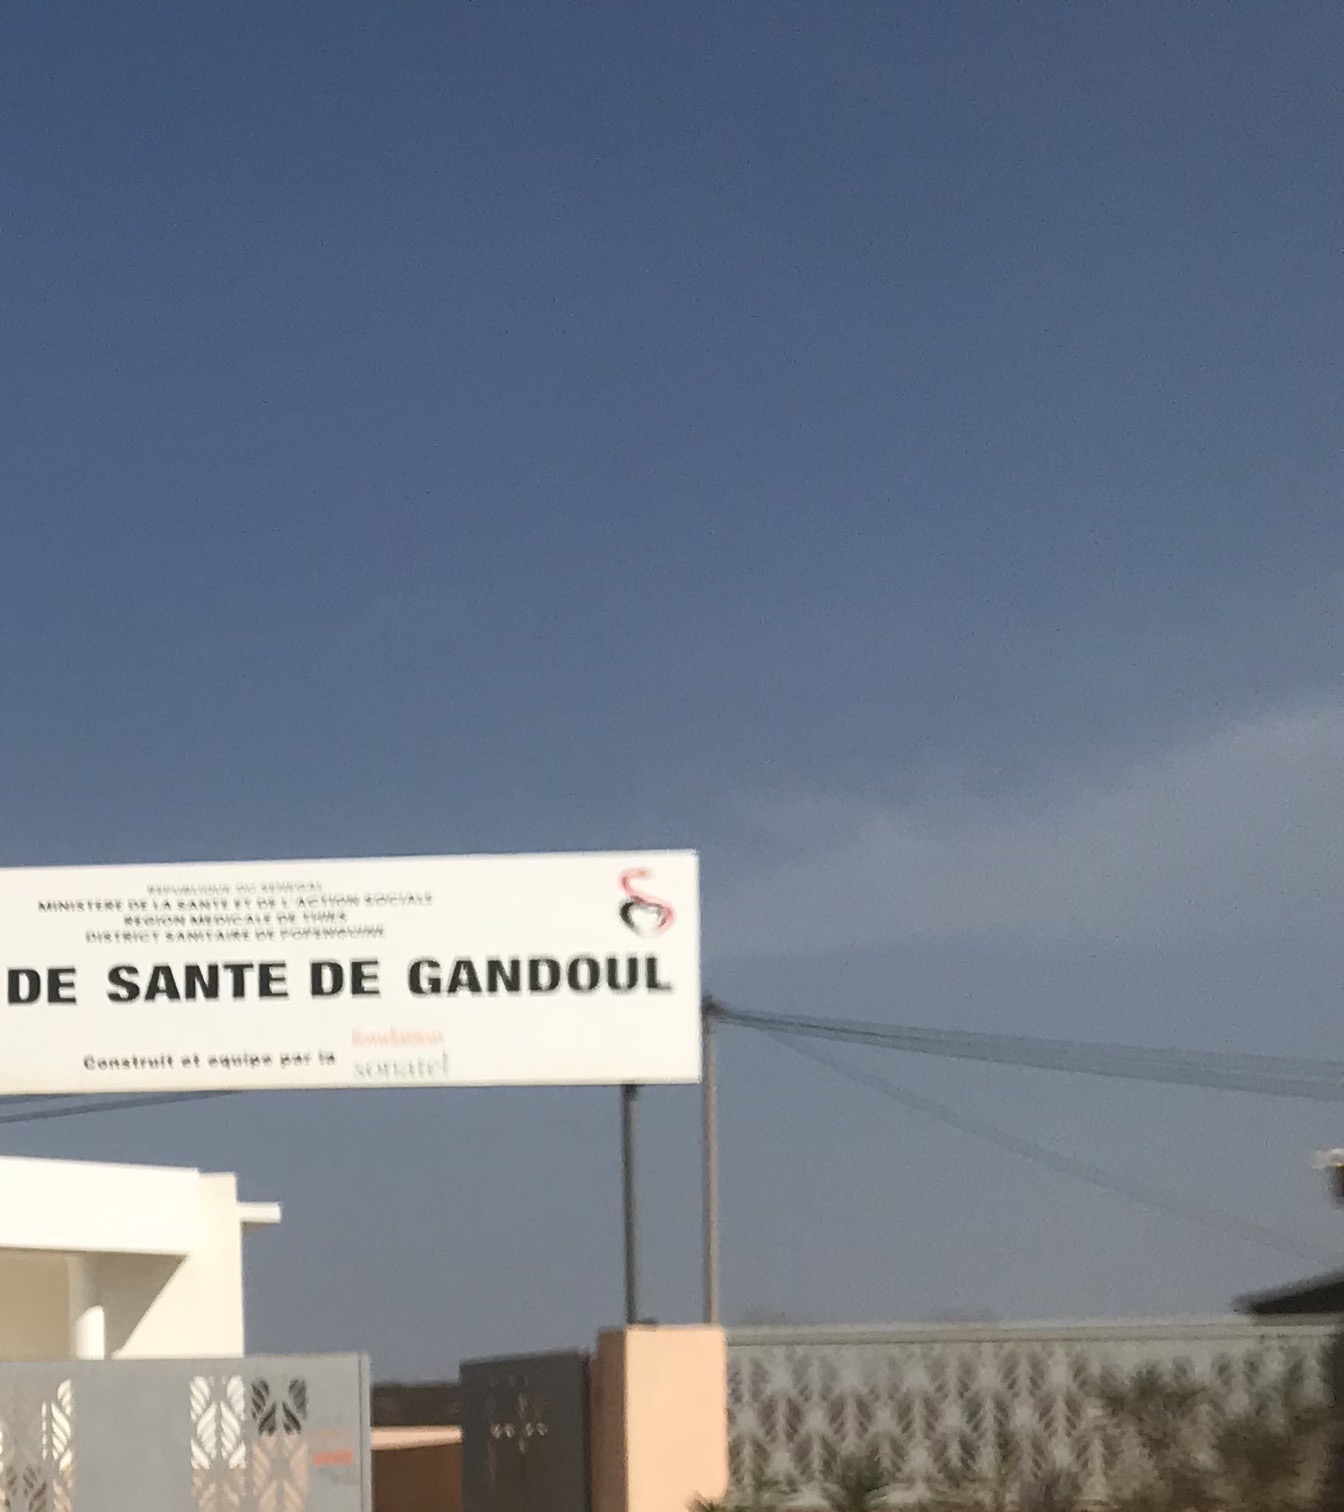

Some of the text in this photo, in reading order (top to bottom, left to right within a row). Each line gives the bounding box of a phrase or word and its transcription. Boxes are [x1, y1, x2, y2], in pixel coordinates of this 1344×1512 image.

[236, 882, 256, 894] DU
[37, 898, 124, 913] MINISTERE
[127, 898, 148, 911] DE
[152, 898, 172, 911] LA
[232, 897, 251, 910] ET
[256, 896, 276, 910] DE
[363, 890, 433, 906] SOCIALE
[123, 914, 186, 926] REGION
[190, 912, 271, 926] MEDICALE
[277, 912, 296, 924] DE
[85, 929, 160, 944] DISTRICT
[165, 927, 249, 943] SANITAIRE
[255, 925, 274, 941] DE
[7, 966, 77, 1005] DE
[107, 961, 289, 1003] SANTE
[310, 958, 380, 997] DE
[408, 953, 673, 997] GANDOUL
[82, 1053, 174, 1070] Construit
[180, 1053, 200, 1068] et
[278, 1051, 311, 1068] par
[317, 1049, 337, 1066] la
